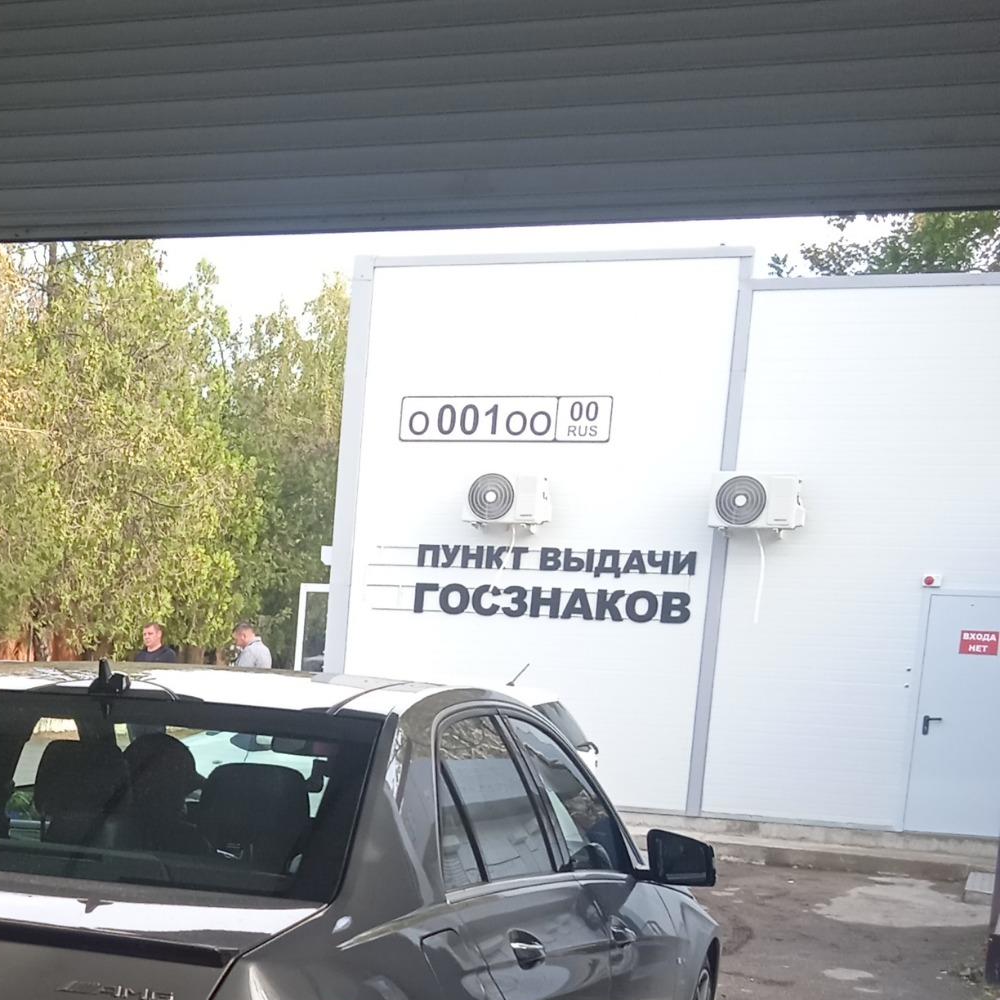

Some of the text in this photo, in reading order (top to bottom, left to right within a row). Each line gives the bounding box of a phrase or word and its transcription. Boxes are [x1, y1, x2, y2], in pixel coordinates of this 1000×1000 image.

[569, 400, 599, 422] 00
[567, 425, 598, 437] RUS
[417, 543, 698, 579] ПУНКТ ВЫДАЧИ
[413, 582, 692, 625] ГОСЗНАКОВ
[962, 632, 997, 641] ВХОДА
[968, 644, 988, 653] НЕТ
